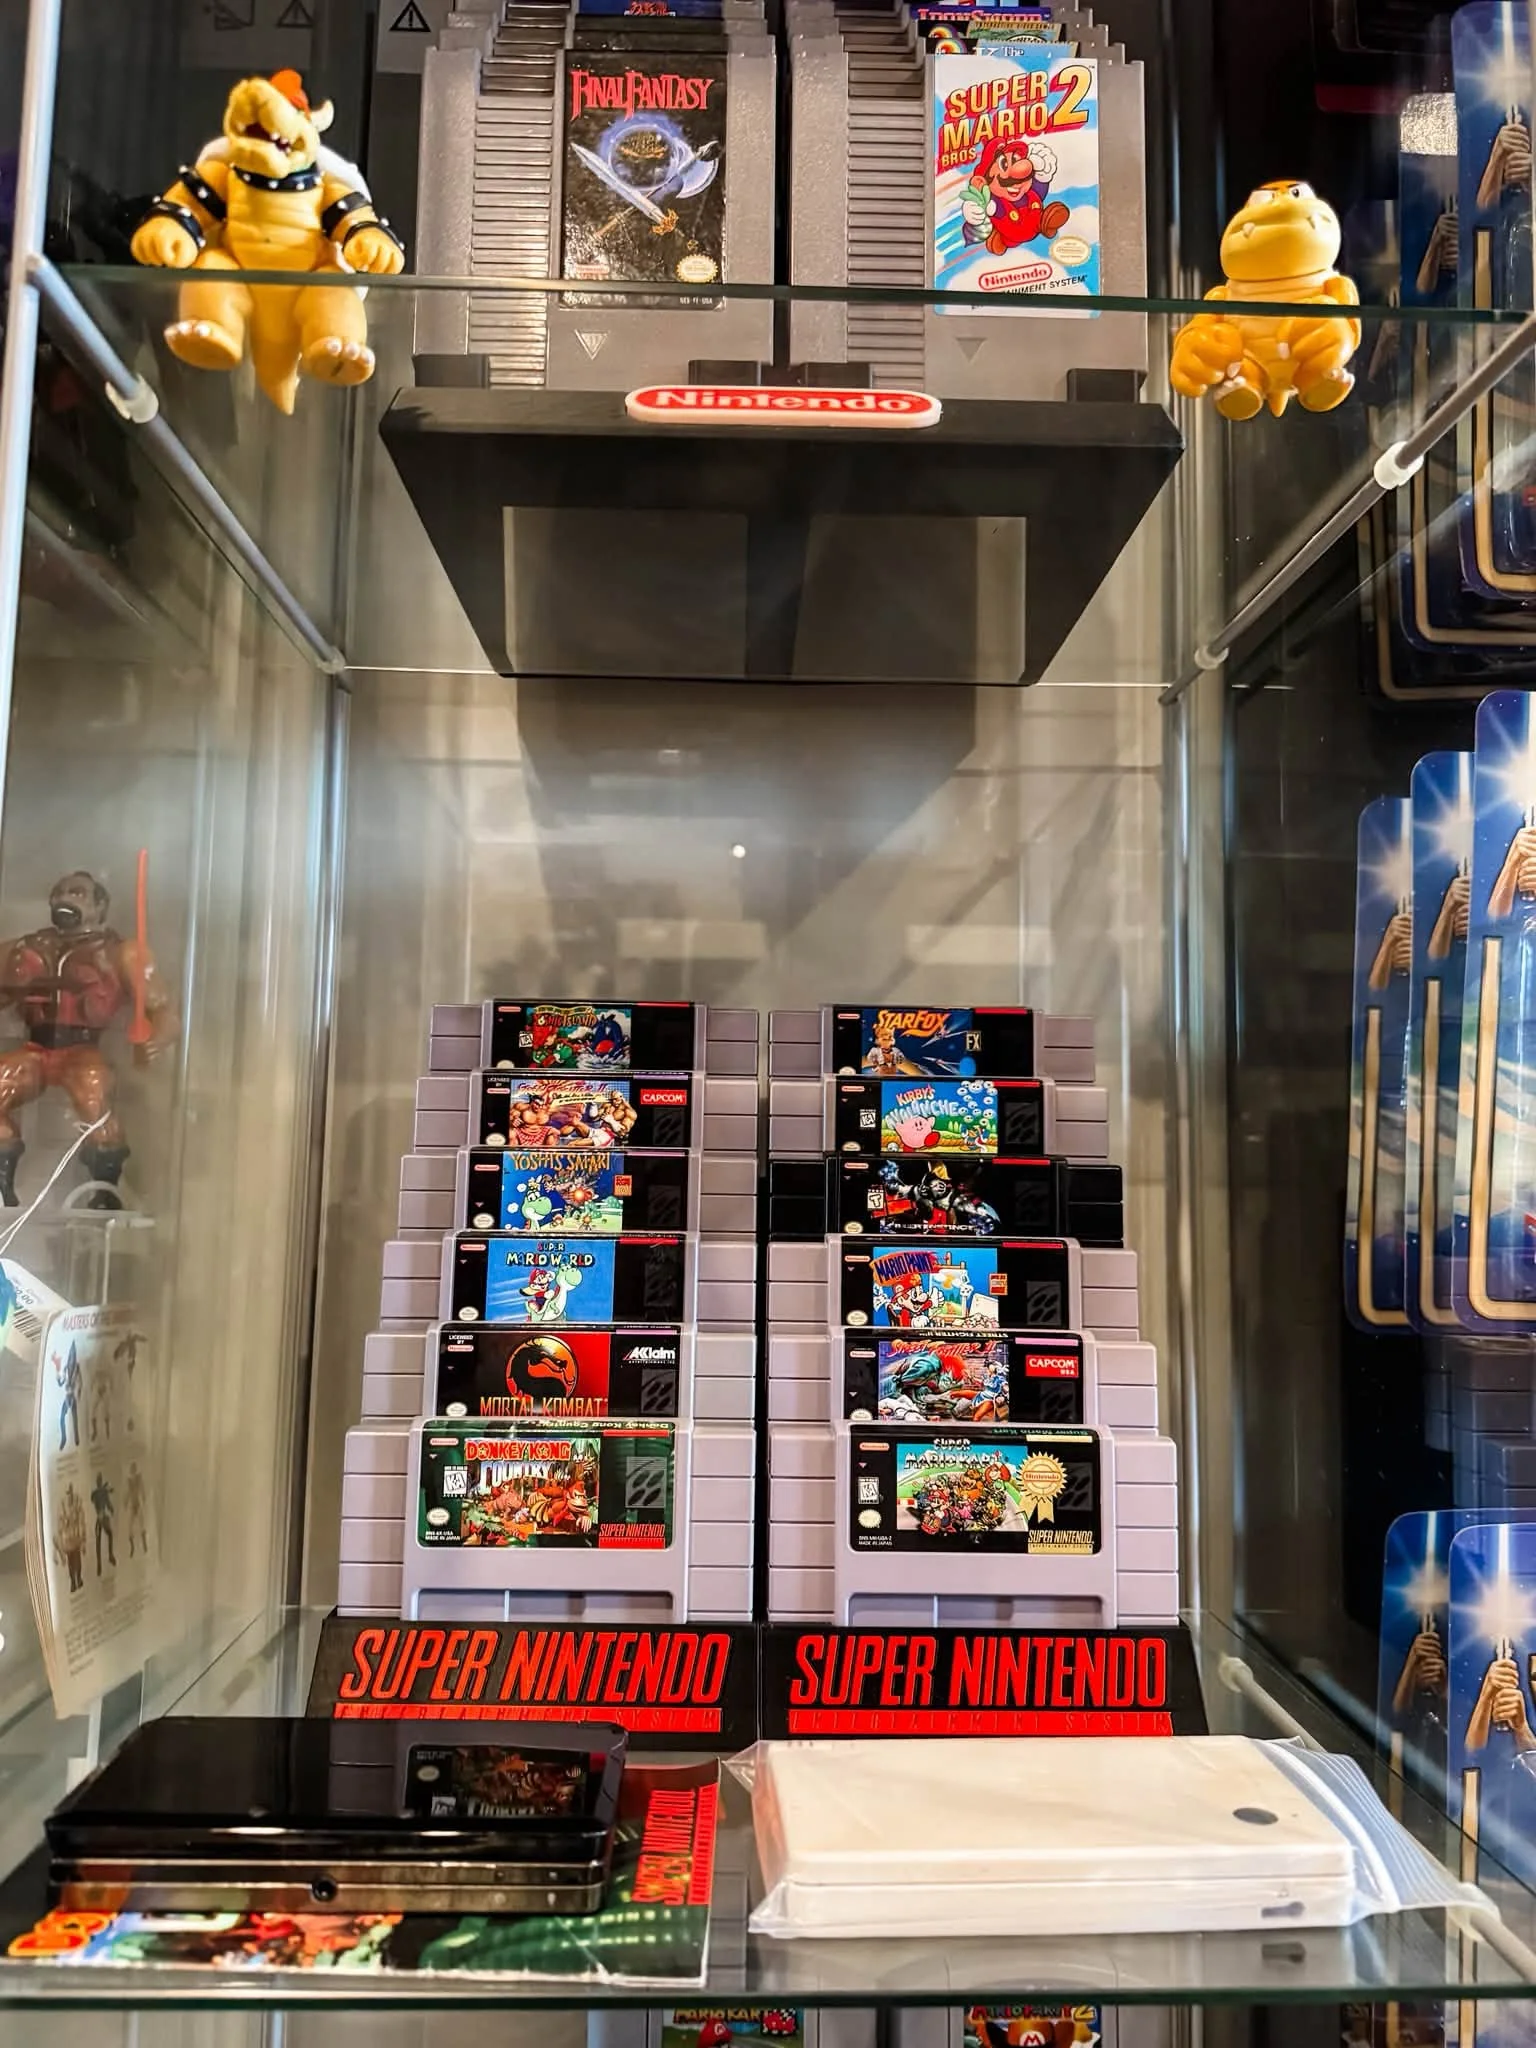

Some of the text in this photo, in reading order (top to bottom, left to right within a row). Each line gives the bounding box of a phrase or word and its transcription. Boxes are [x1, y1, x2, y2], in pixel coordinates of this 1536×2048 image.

[570, 69, 714, 121] FINAL FANTASY
[946, 70, 1048, 119] SUPER
[940, 64, 1092, 155] MARIO 2
[984, 267, 1048, 288] Nintendo
[655, 391, 913, 412] Nintendo
[642, 1094, 685, 1103] CAPCOM
[506, 1252, 595, 1267] MARIO WORLD
[1028, 1358, 1075, 1368] CAPCOM
[480, 1397, 602, 1417] MORTAL KOMBAT
[465, 1440, 572, 1460] DONKEY KONG
[904, 1452, 957, 1469] MARIO
[599, 1523, 666, 1537] SUPER NINTENDO
[1028, 1530, 1054, 1543] SUPER
[339, 1629, 731, 1704] SUPER NINTENDO
[789, 1635, 1166, 1707] SUPER NINTENDO
